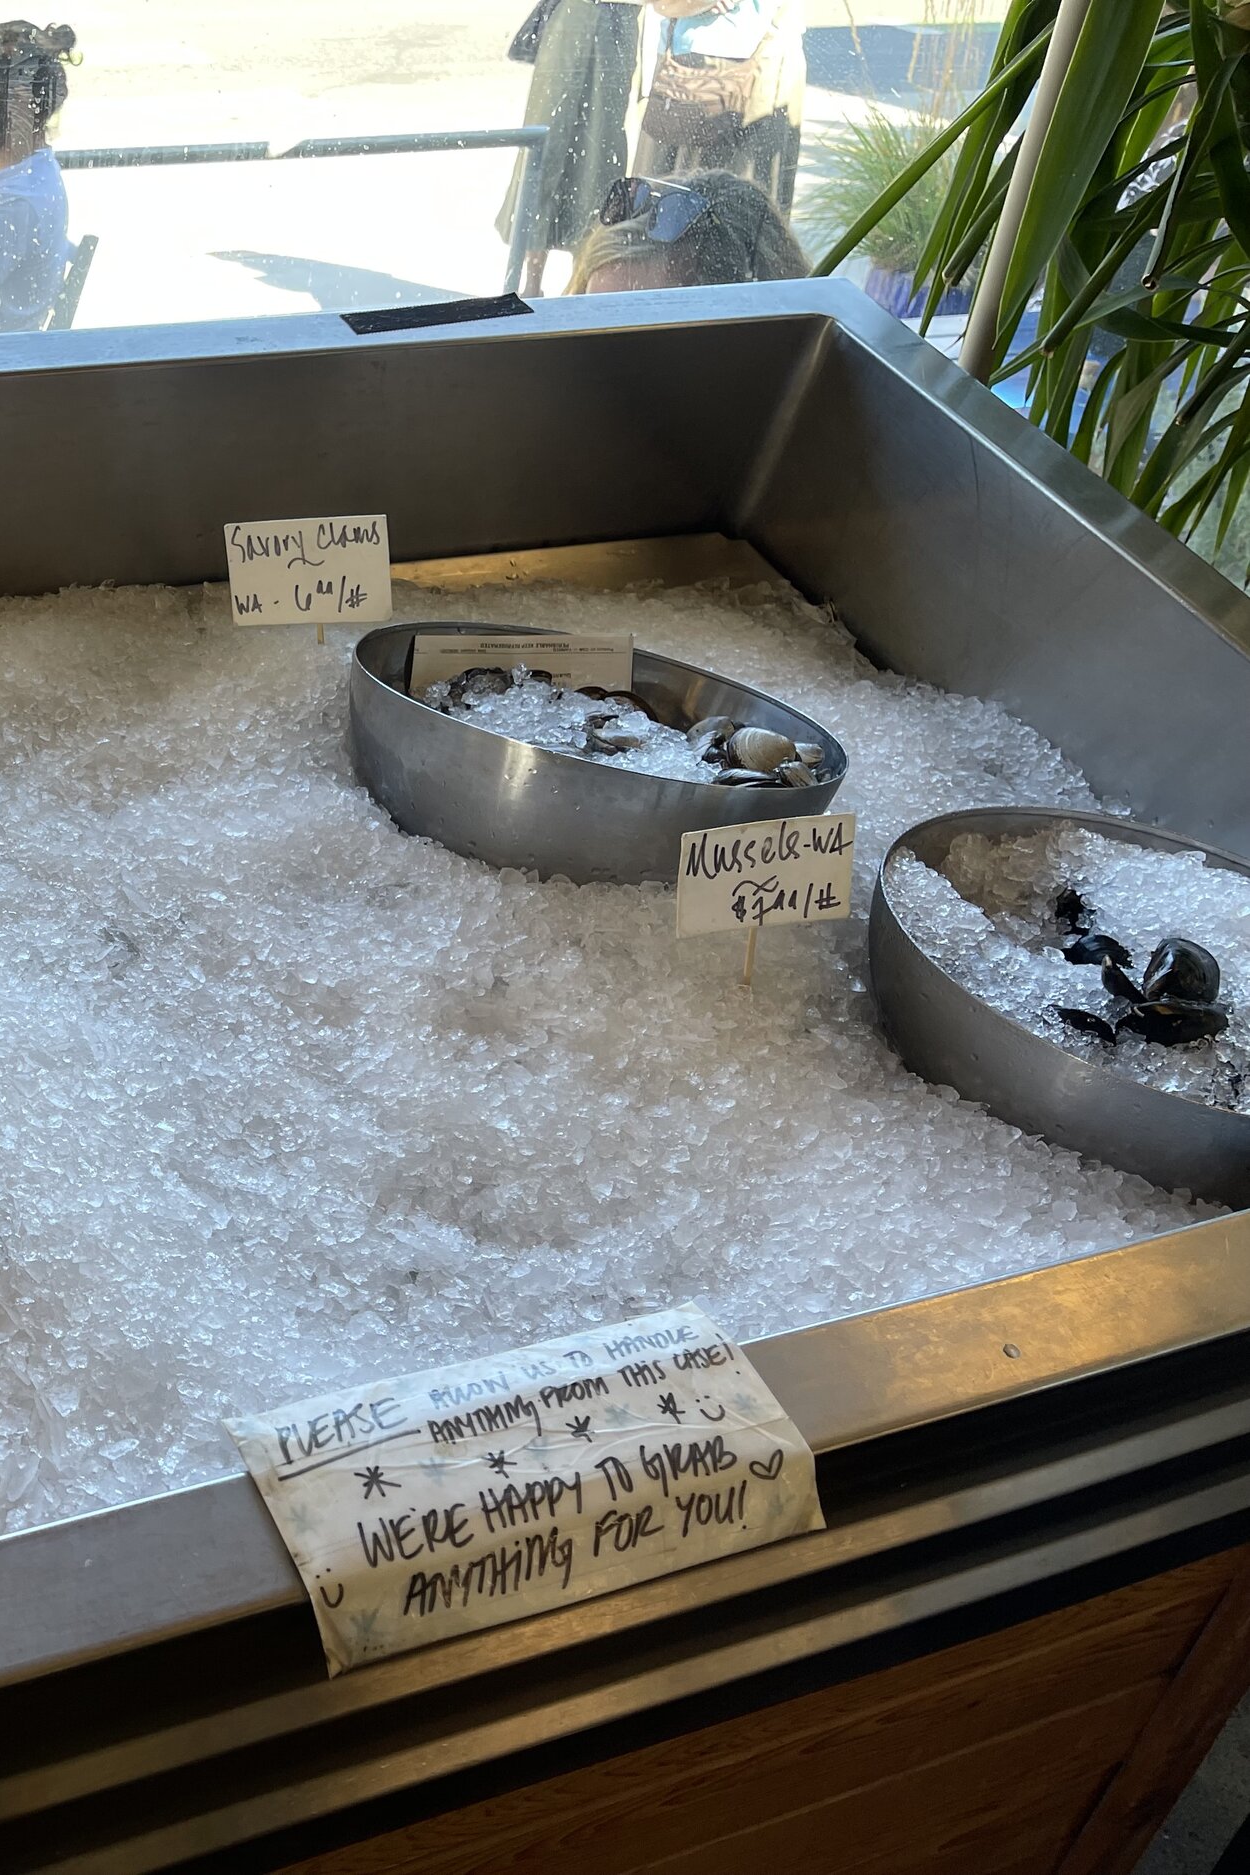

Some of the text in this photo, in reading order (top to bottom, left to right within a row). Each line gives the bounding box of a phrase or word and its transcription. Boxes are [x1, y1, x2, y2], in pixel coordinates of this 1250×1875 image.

[317, 521, 380, 550] Clams
[235, 594, 262, 615] WA
[275, 1398, 409, 1465] PLEASE
[523, 1359, 556, 1381] US
[563, 1350, 594, 1369] TO
[603, 1326, 700, 1360] HANDLE
[538, 1377, 610, 1408] FROM
[478, 1471, 582, 1533] HAPPY
[594, 1456, 635, 1500] TO
[639, 1434, 737, 1497] GRAB
[593, 1505, 664, 1557] FOR
[676, 1479, 748, 1538] YOU!
